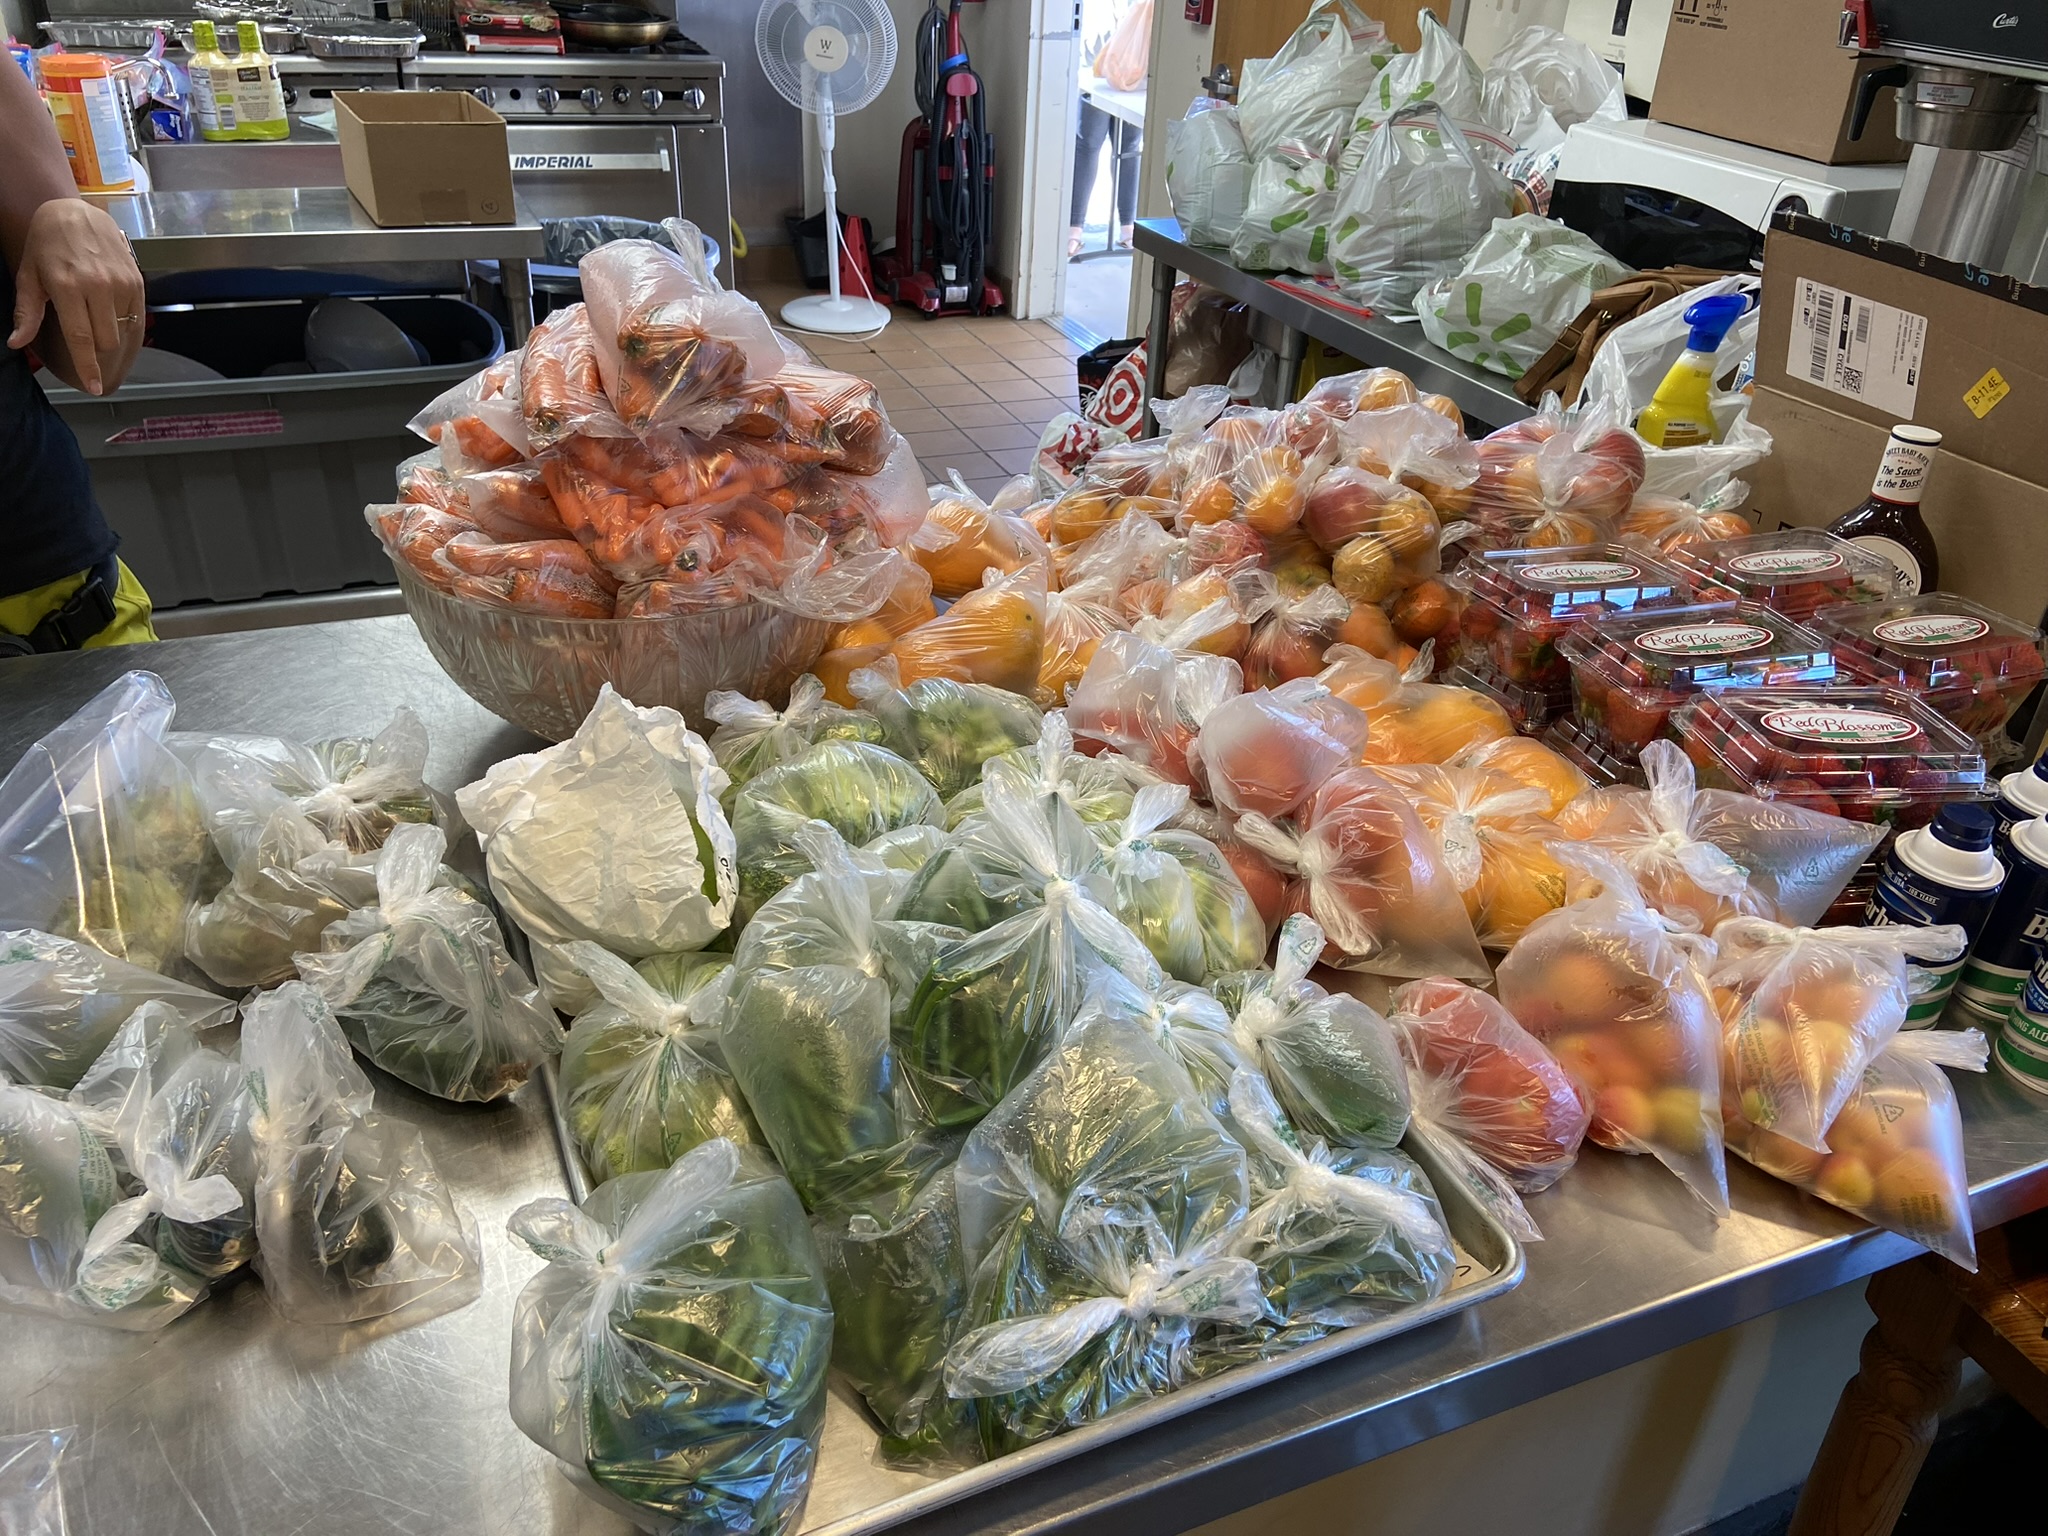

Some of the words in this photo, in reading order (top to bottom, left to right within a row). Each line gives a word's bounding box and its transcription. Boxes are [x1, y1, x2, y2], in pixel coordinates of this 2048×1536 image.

[820, 38, 832, 50] W
[515, 156, 593, 168] IMPERIAL
[1836, 353, 1844, 375] CYCLE
[1901, 447, 1918, 457] BABY
[1881, 465, 1894, 475] The
[1895, 466, 1923, 476] Sauce
[1876, 477, 1882, 487] is
[1883, 478, 1898, 488] the
[1899, 476, 1924, 488] Boss!
[1740, 557, 1767, 569] Red
[1766, 556, 1825, 568] Blossom
[1531, 566, 1560, 578] Red
[1560, 566, 1621, 578] Blossom
[1884, 626, 1912, 638] Red
[1911, 623, 1970, 636] Blossom
[1646, 633, 1682, 648] Red
[1681, 632, 1752, 646] Blossom
[1775, 715, 1815, 732] Red
[1815, 717, 1895, 732] Blossom
[1893, 875, 1906, 889] USA
[1919, 891, 1937, 905] YEARS
[1872, 1105, 1888, 1136] RECYCLABLE
